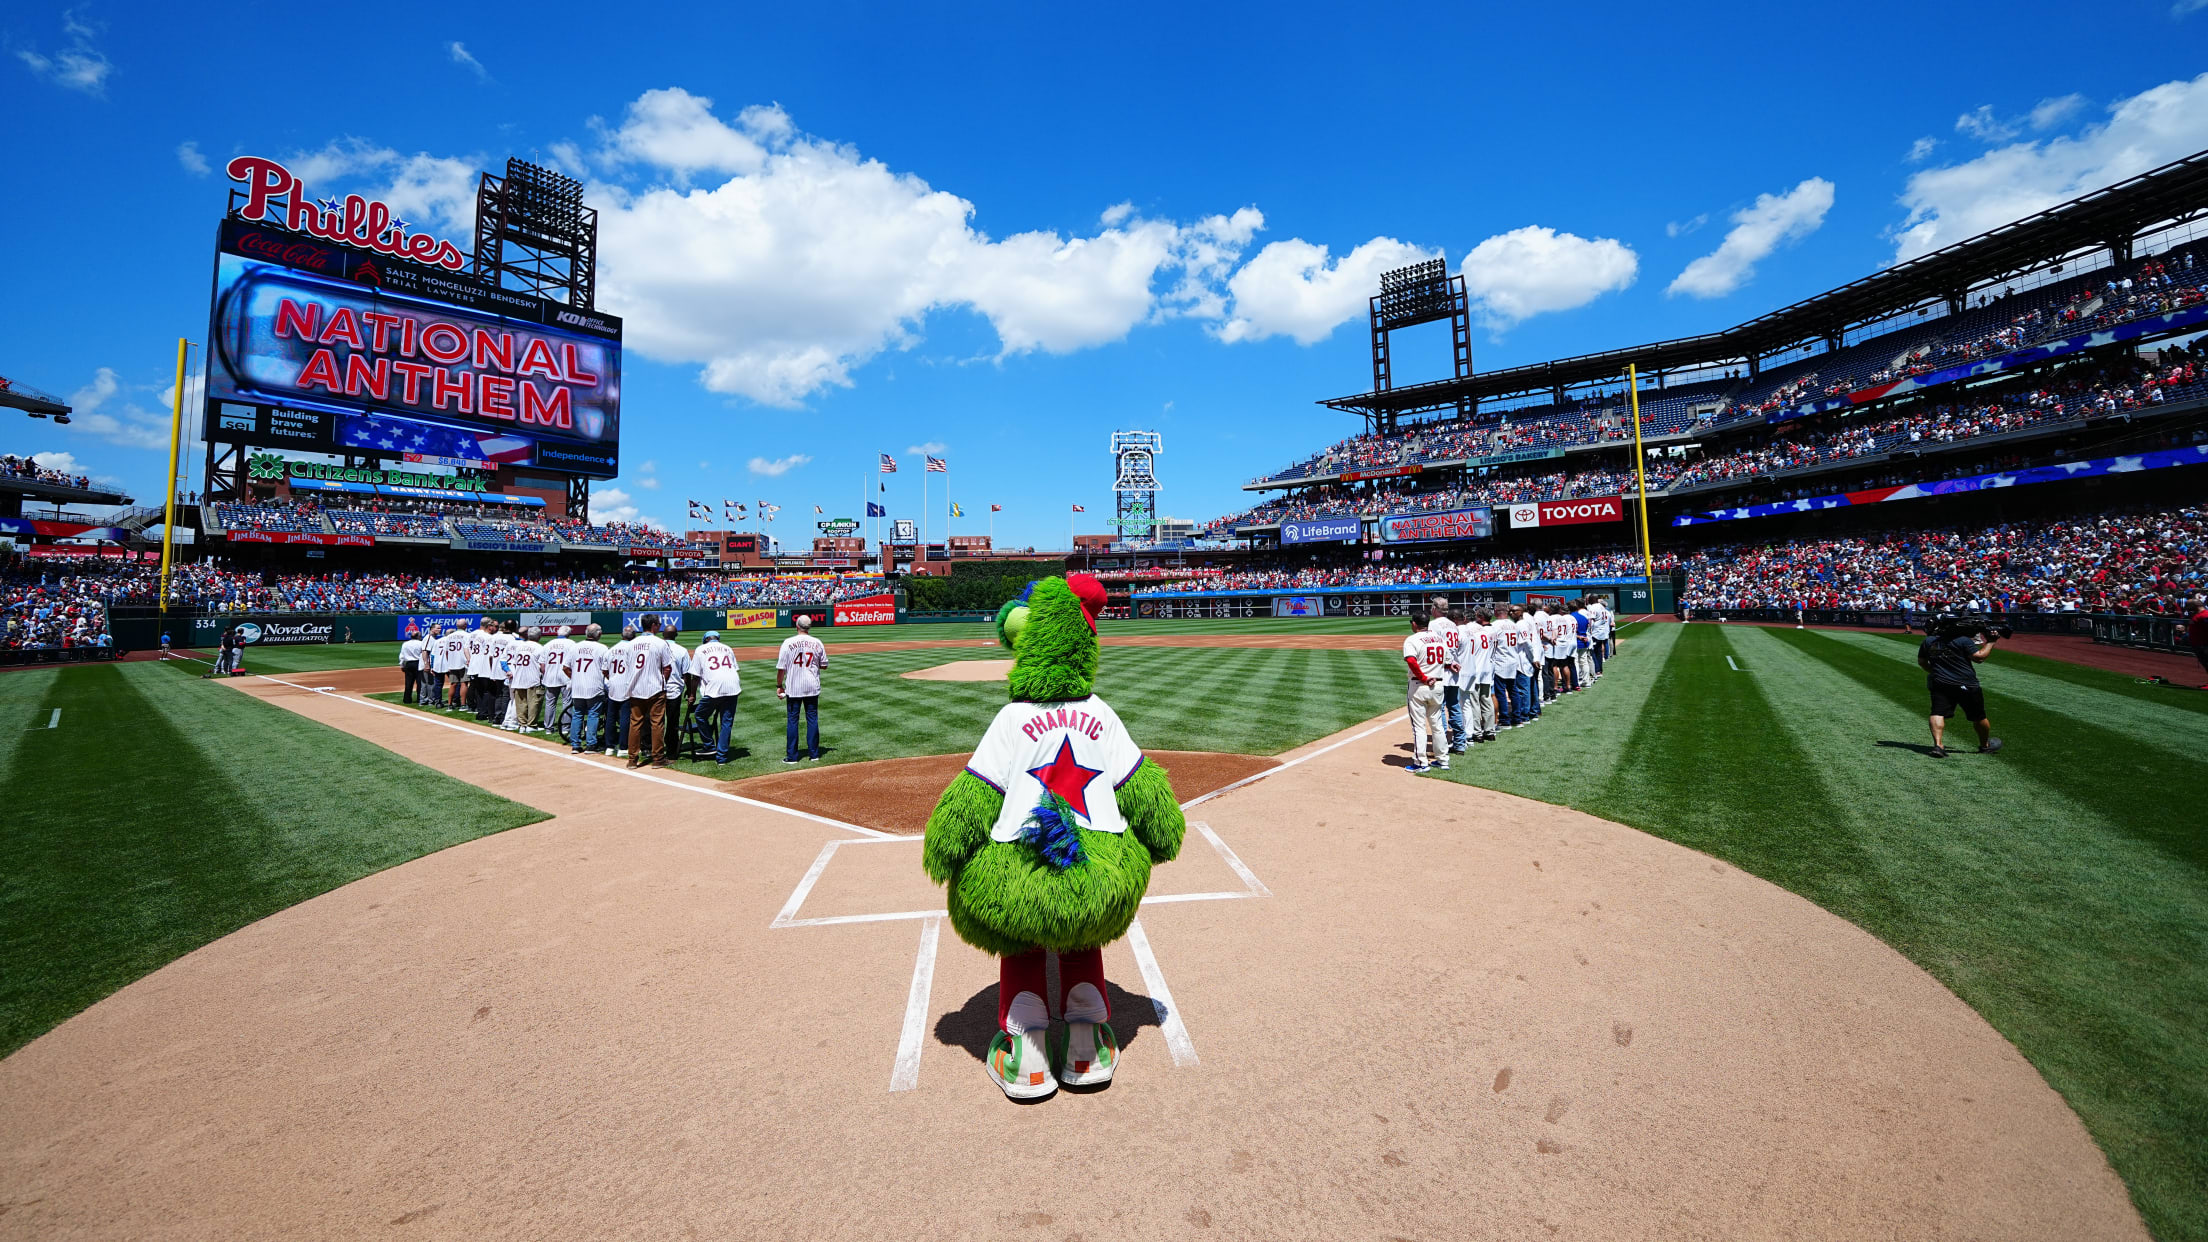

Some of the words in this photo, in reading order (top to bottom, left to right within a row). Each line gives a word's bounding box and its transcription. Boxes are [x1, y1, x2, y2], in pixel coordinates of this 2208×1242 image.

[226, 155, 464, 271] Phillies
[385, 267, 417, 281] SALTZ
[422, 277, 486, 297] MONGELUZZI
[490, 292, 538, 309] BENDESKY
[385, 276, 418, 290] TRIAL
[426, 286, 475, 303] LAWYERS
[556, 311, 587, 327] KDI
[274, 298, 598, 386] NATIONAL
[296, 348, 572, 430] ANTHEM
[271, 409, 319, 424] Building
[271, 418, 304, 429] brave
[542, 449, 605, 464] Independence
[1480, 453, 1512, 465] LISCIO'S
[1514, 450, 1549, 461] BAKERY
[289, 461, 384, 484] Citizens
[387, 468, 441, 489] Bank
[443, 475, 488, 492] Park
[1360, 467, 1401, 478] McDonald's
[1542, 503, 1616, 520] TOYOTA
[1108, 517, 1145, 525] Citizens
[1146, 517, 1167, 525] Bank
[1391, 513, 1483, 531] NATIONAL
[231, 532, 249, 542] JIM
[250, 530, 272, 543] BEAM
[1128, 527, 1147, 535] Park
[1302, 523, 1357, 537] LifeBrand
[1397, 524, 1475, 540] ANTHEM
[285, 534, 300, 544] JIM
[301, 532, 323, 545] BEAM
[335, 536, 350, 545] JIM
[350, 534, 371, 546] BEAM
[468, 541, 507, 551] LISCIO'S
[509, 543, 545, 552] BAKERY
[675, 550, 702, 558] TOYOTA
[1285, 601, 1310, 610] Phillies
[196, 619, 216, 629] 334
[263, 622, 333, 636] NovaCare
[263, 635, 329, 643] REHABILITATION
[448, 641, 462, 652] 50
[1480, 634, 1489, 650] 8
[1505, 632, 1517, 647] 15
[517, 653, 531, 667] 28
[548, 651, 564, 665] 21
[635, 653, 646, 670] 9
[708, 655, 732, 671] 34
[793, 652, 814, 668] 47
[1426, 646, 1444, 665] 59
[576, 657, 594, 673] 17
[611, 658, 626, 674] 16
[1021, 708, 1104, 743] PHANATIC
